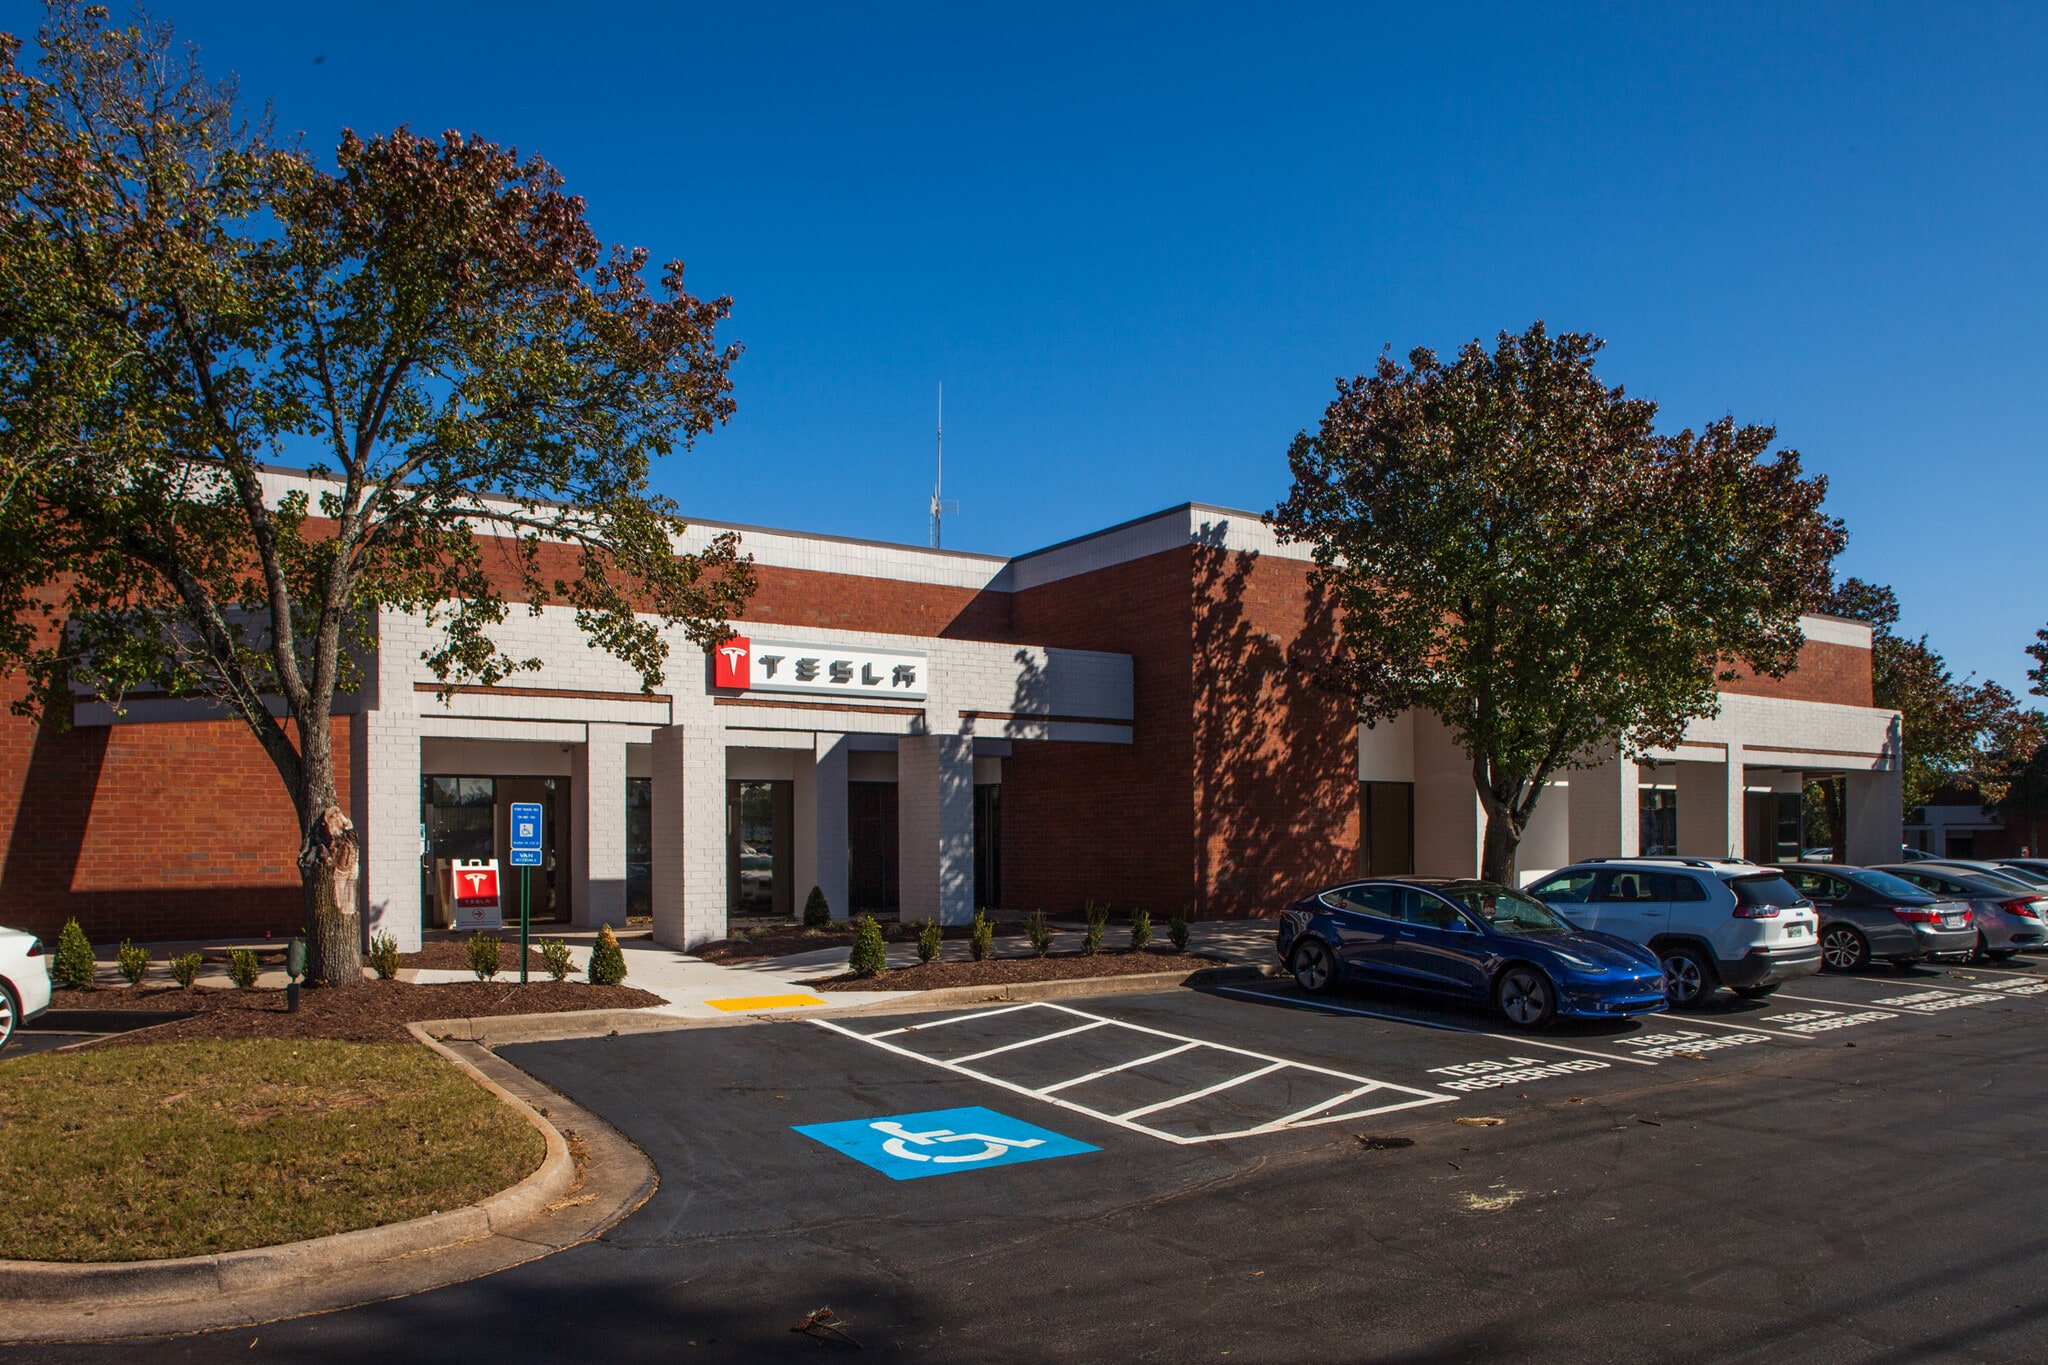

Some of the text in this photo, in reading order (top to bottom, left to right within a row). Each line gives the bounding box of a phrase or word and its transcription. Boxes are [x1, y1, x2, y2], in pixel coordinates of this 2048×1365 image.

[762, 654, 916, 684] TESLA
[1903, 993, 2006, 1011] RESERVED
[1759, 1010, 1844, 1023] TESLA
[1781, 1011, 1899, 1033] RESERVED
[1613, 1030, 1712, 1046] TESLA
[1631, 1033, 1772, 1059] RESERVED
[1426, 1056, 1546, 1077] TESLA
[1437, 1059, 1611, 1092] RESERVED
